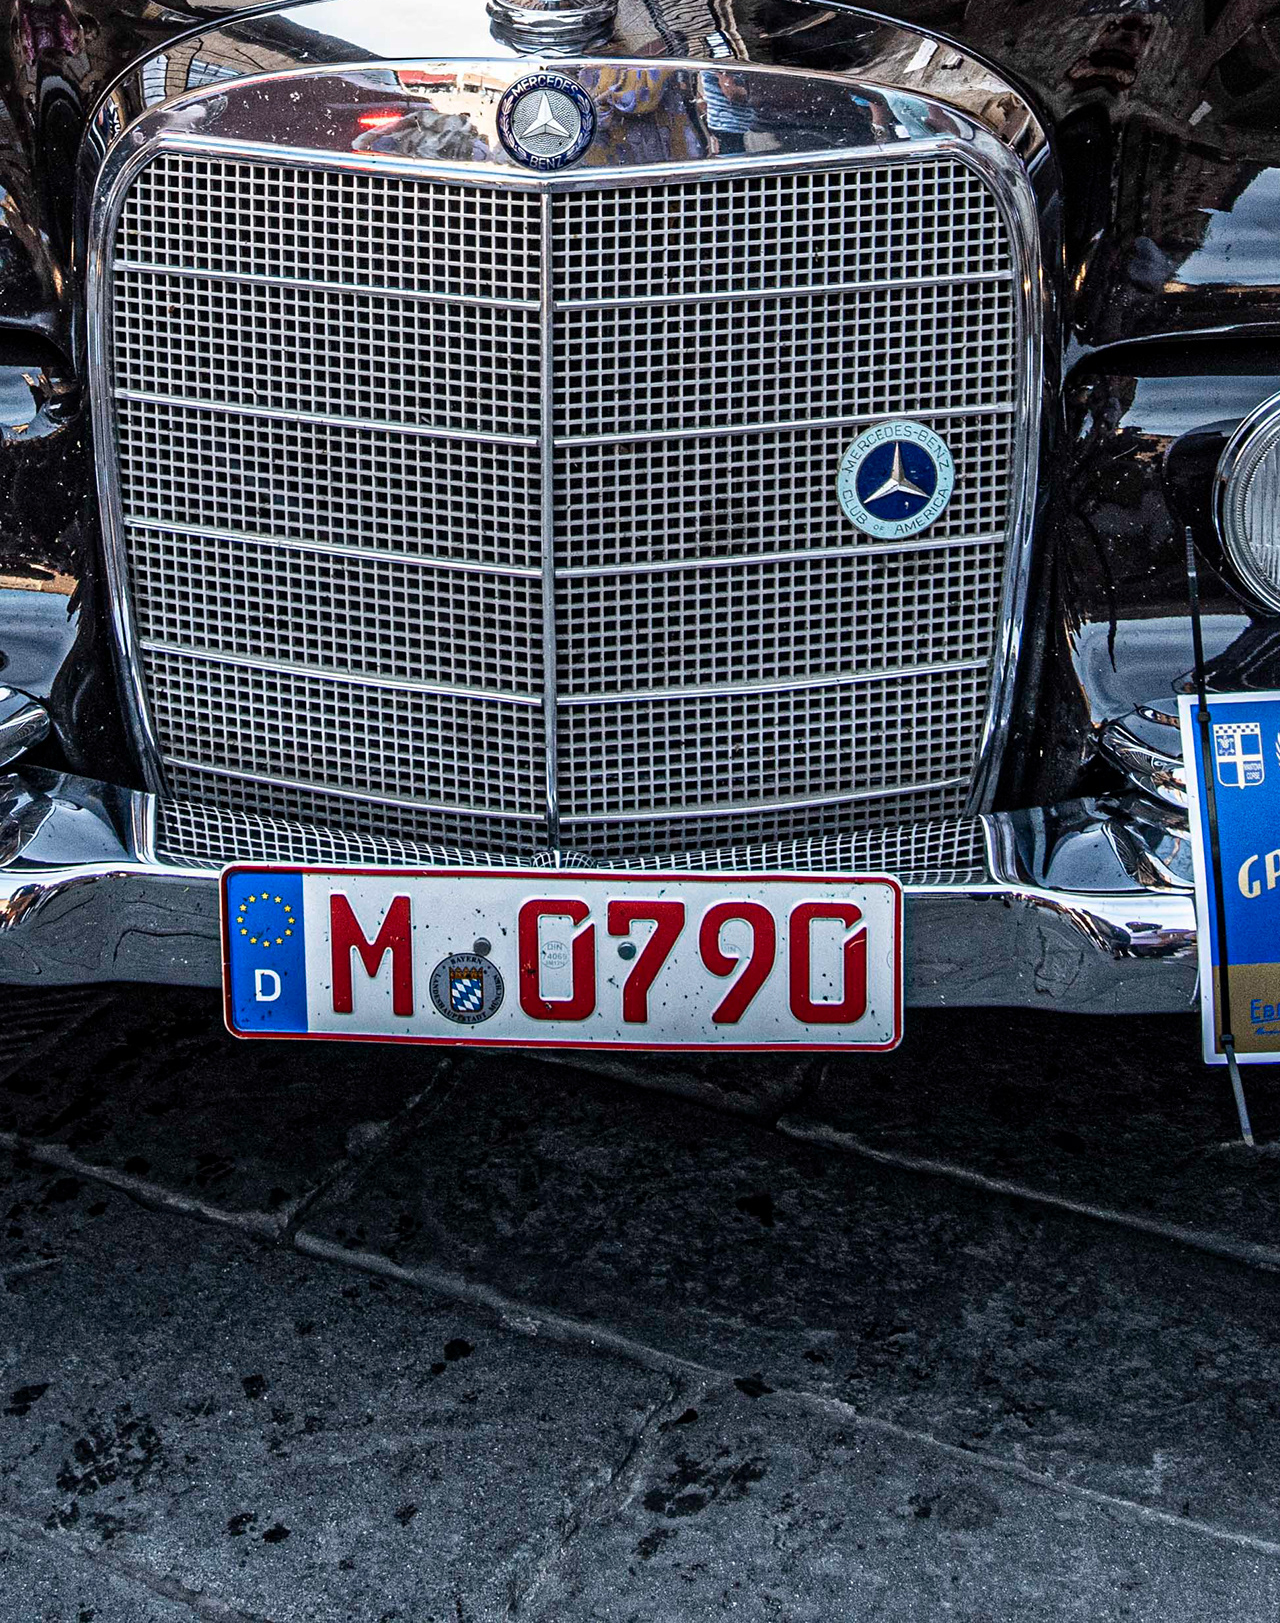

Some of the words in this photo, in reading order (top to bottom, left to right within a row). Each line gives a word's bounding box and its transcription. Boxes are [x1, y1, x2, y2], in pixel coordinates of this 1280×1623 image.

[511, 75, 579, 97] MERCEDES
[528, 155, 565, 170] BENZ
[841, 424, 950, 474] MERCEDES-BENZ
[841, 489, 868, 525] CLUB
[894, 487, 949, 536] AMERICA
[328, 892, 414, 1017] M
[518, 897, 869, 1026] 0790
[450, 955, 483, 965] BAYERN
[254, 968, 282, 1003] D
